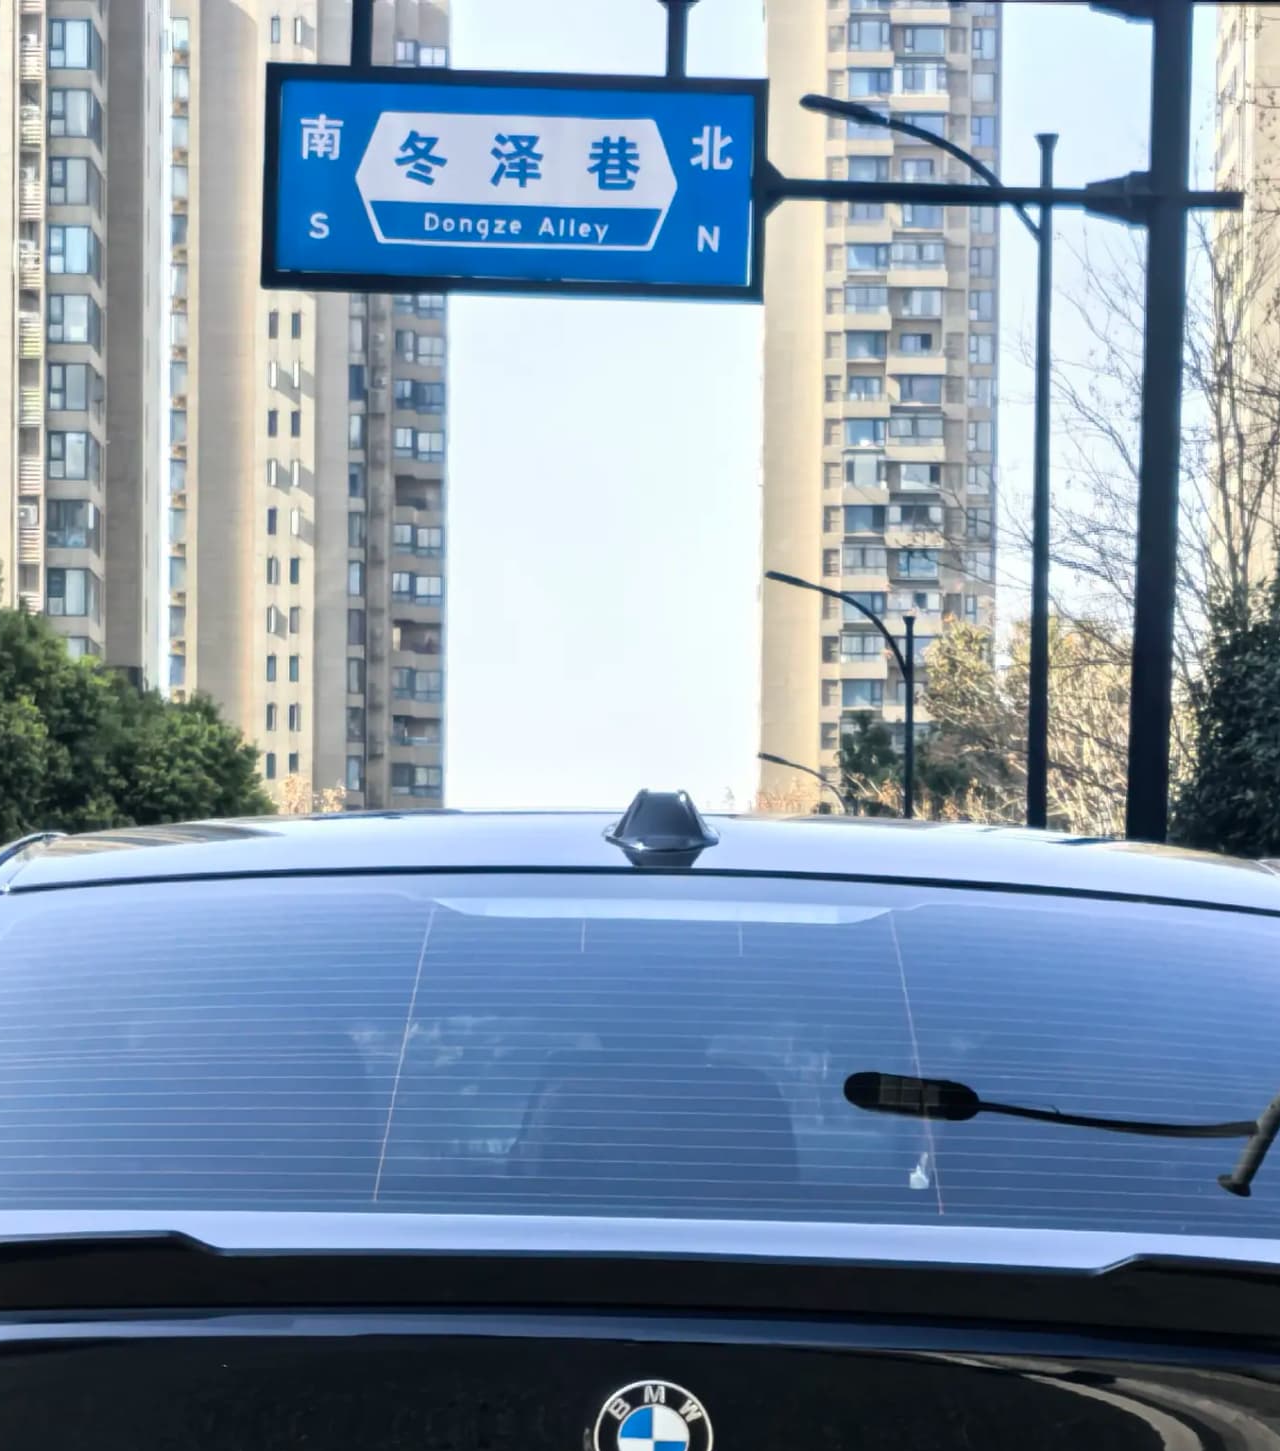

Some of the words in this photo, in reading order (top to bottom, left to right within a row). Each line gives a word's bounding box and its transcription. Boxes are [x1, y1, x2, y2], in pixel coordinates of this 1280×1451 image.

[300, 114, 344, 161] 南
[690, 125, 734, 172] 北
[394, 129, 641, 191] 冬泽巷
[308, 212, 330, 240] S
[424, 212, 523, 242] Dongze
[538, 218, 609, 244] Alley
[697, 225, 720, 253] N
[607, 1385, 703, 1422] BMW
